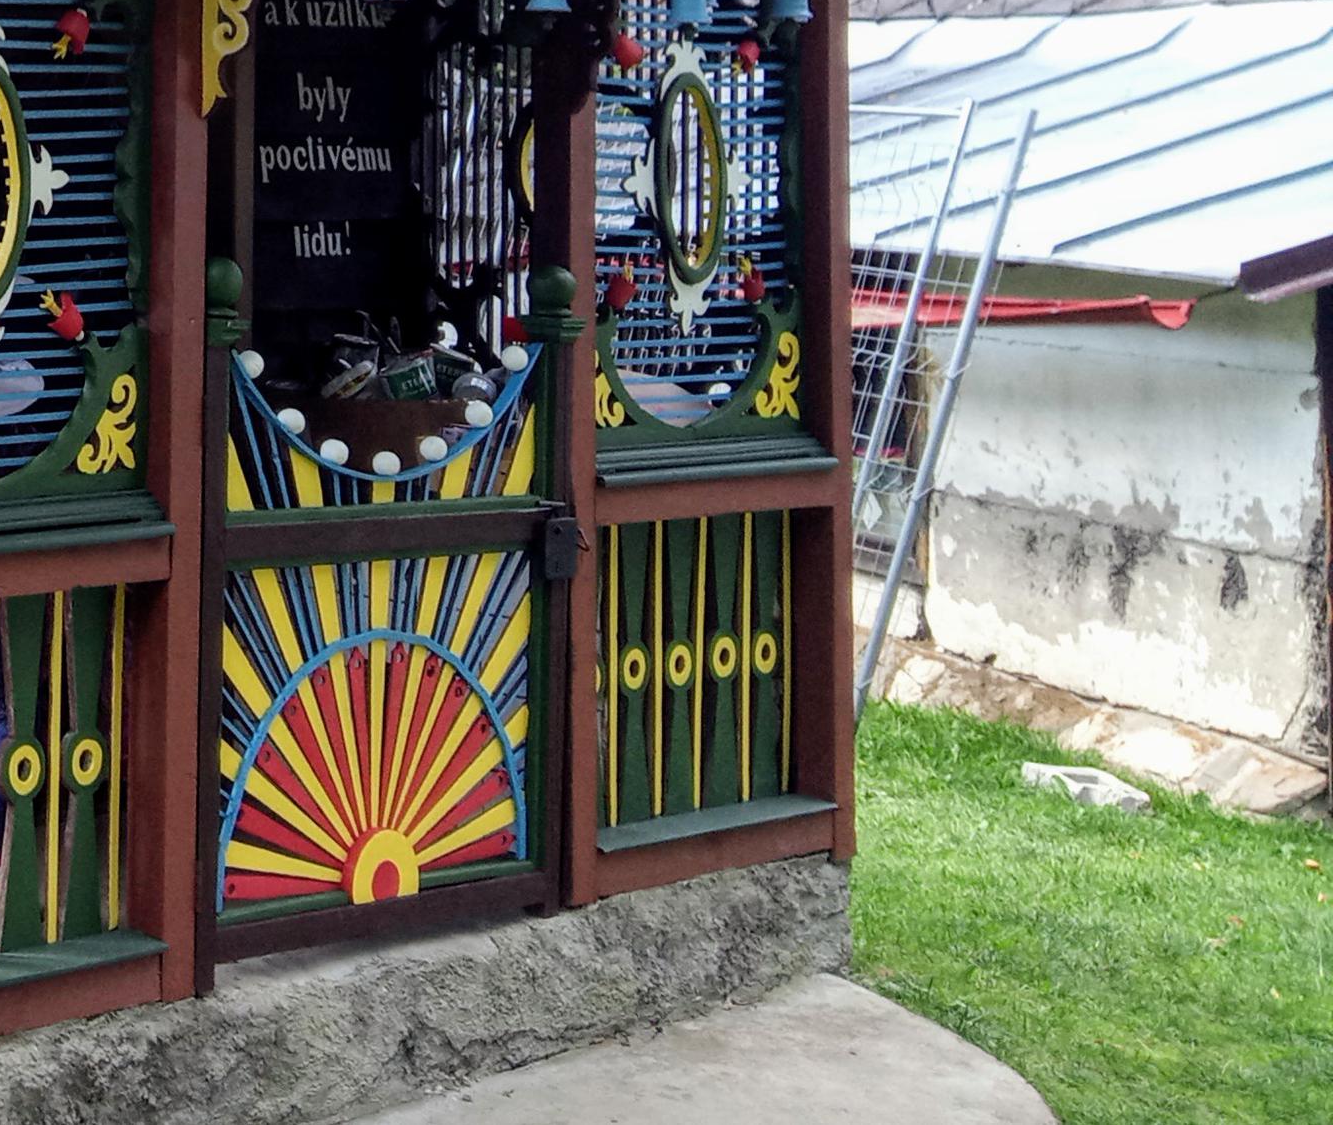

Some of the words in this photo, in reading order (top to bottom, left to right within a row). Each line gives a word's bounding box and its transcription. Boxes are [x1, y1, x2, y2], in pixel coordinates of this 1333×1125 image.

[264, 0, 280, 26] a
[296, 72, 352, 123] byly
[259, 134, 393, 184] poctivému
[293, 221, 352, 259] lidu!
